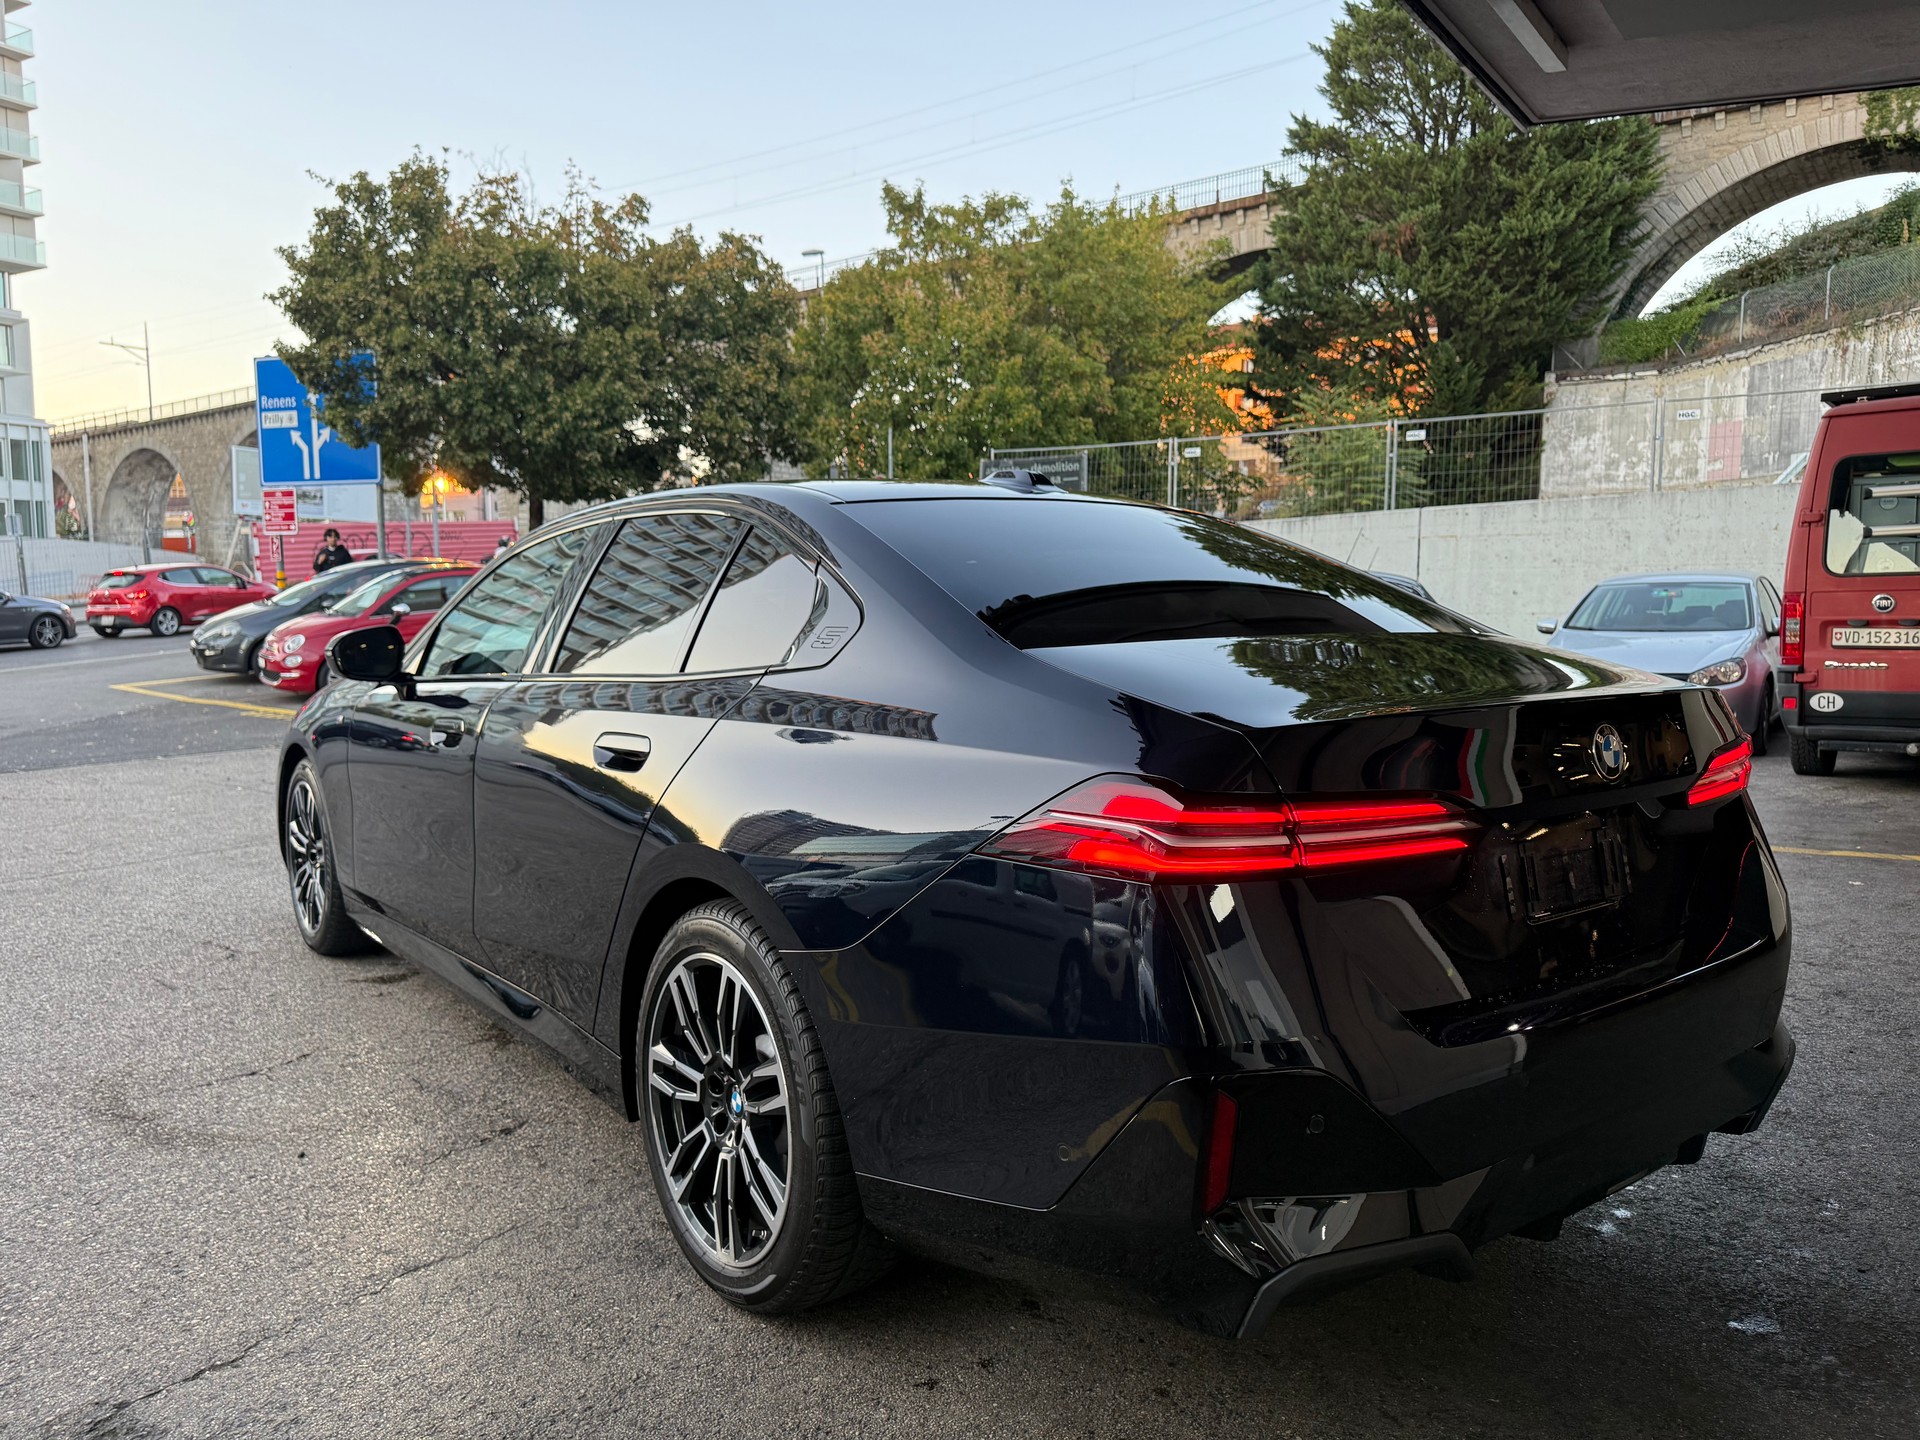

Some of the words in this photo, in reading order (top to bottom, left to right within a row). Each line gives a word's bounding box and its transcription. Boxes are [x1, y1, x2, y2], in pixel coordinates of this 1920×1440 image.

[261, 395, 297, 409] Renens
[264, 413, 283, 427] Prilly
[1031, 461, 1080, 473] démolition
[1818, 695, 1836, 709] CH
